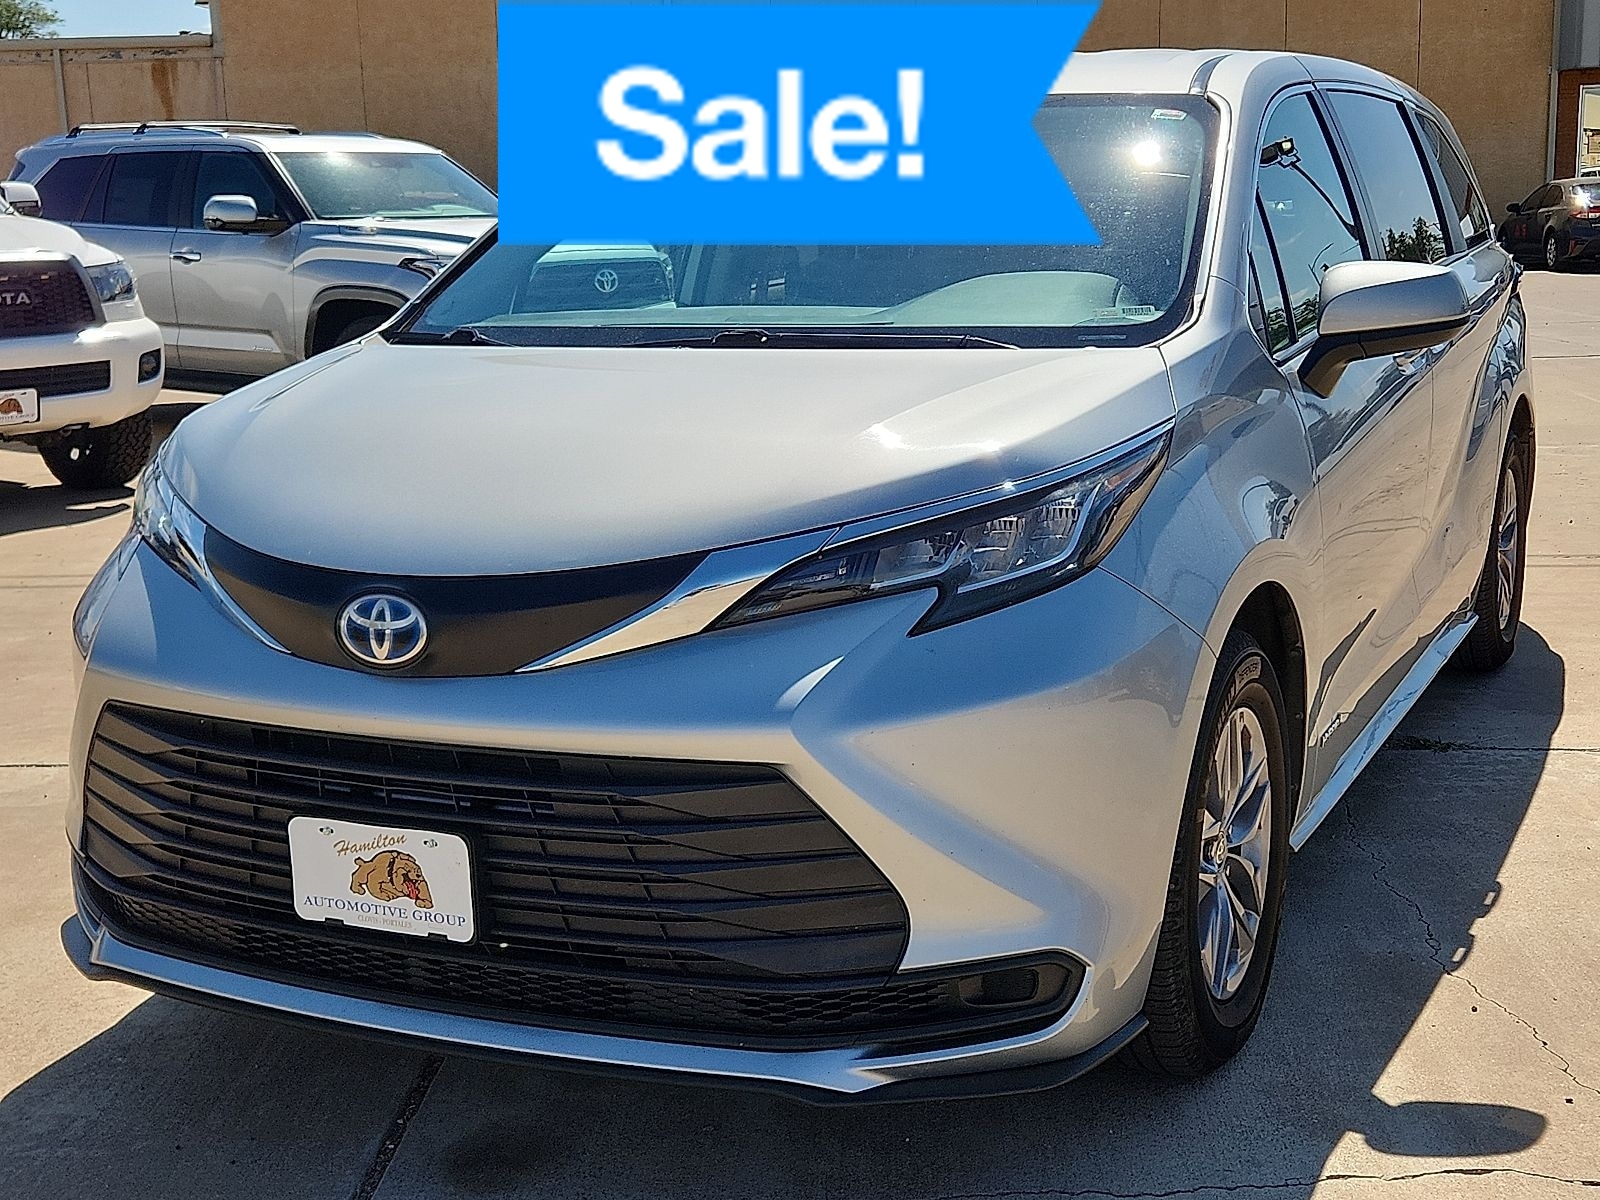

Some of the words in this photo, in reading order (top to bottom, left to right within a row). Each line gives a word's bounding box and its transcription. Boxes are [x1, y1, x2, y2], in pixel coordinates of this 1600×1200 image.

[0, 292, 31, 305] TA
[333, 833, 407, 857] Hamilton
[303, 895, 408, 919] AUTOMOTIVE
[412, 909, 466, 927] GROUP
